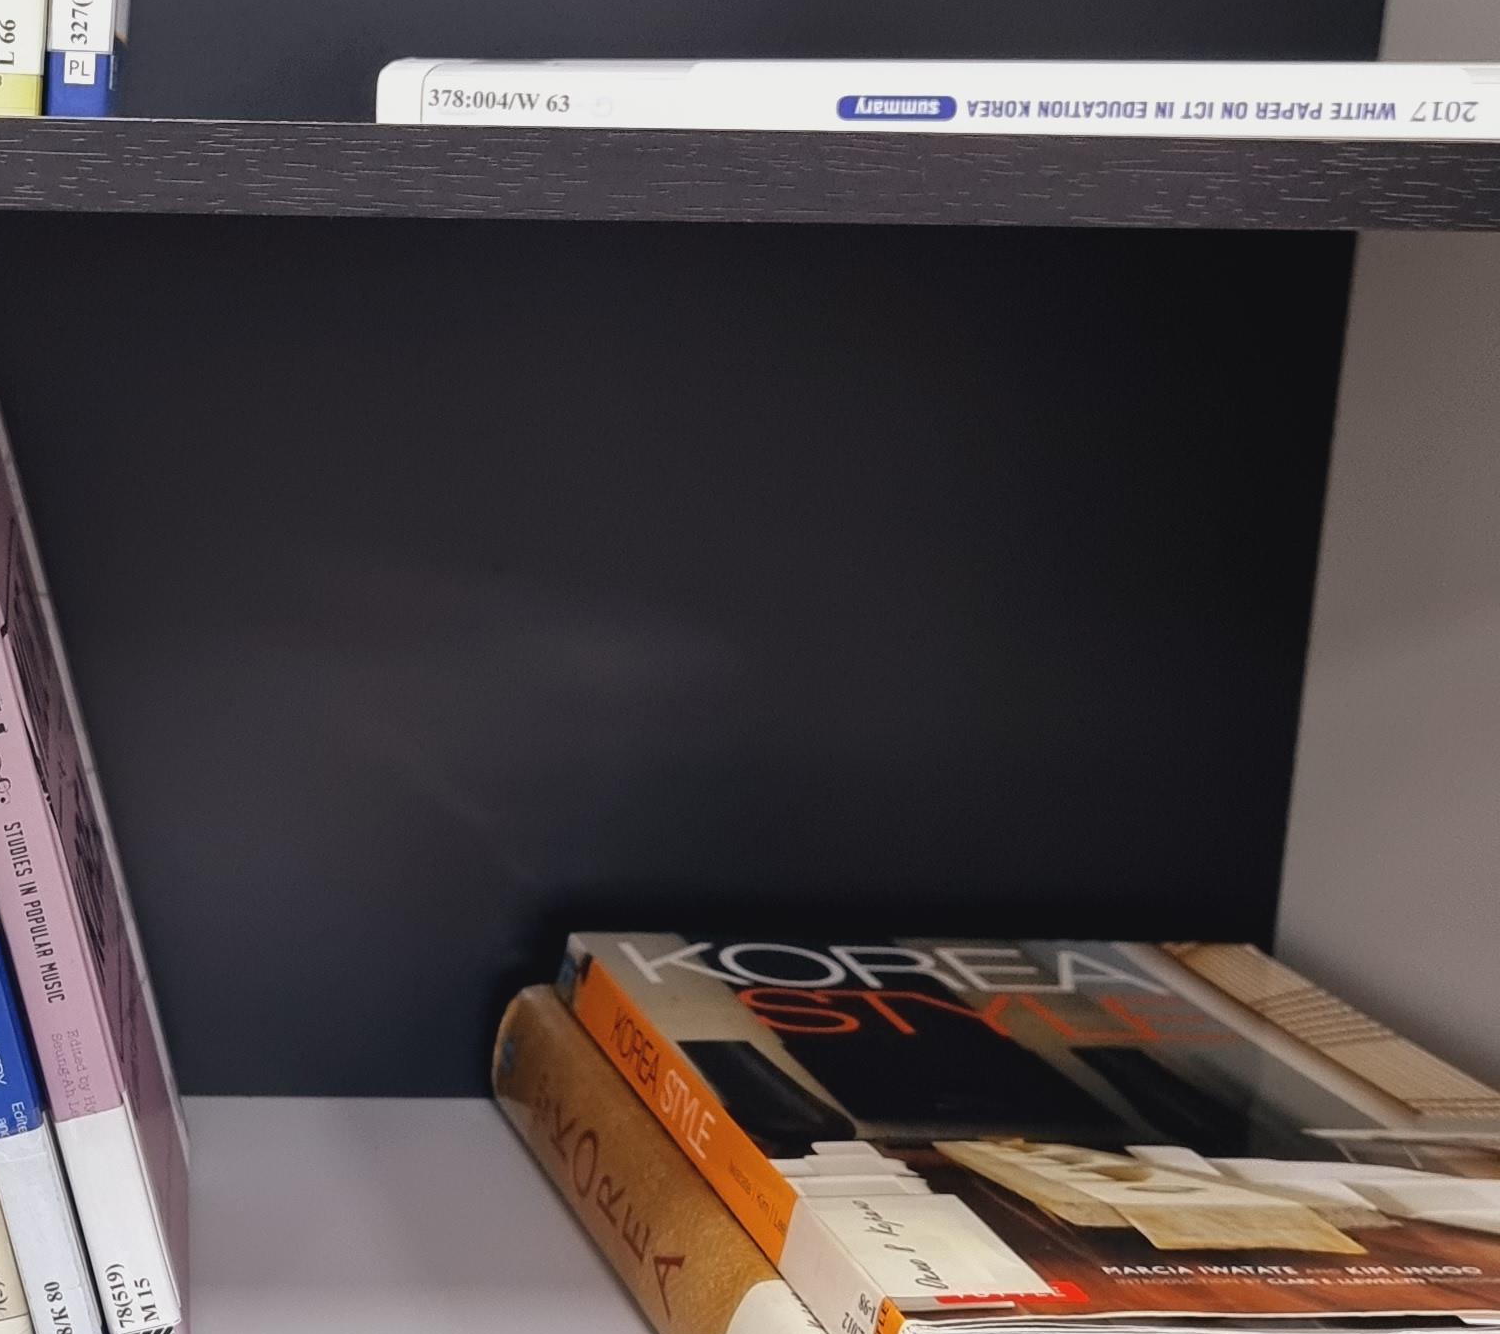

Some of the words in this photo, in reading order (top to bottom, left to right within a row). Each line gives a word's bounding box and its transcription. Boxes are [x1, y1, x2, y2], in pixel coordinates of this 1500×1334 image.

[0, 19, 16, 45] 66
[428, 88, 540, 112] 378:004/W
[546, 94, 570, 113] 63
[966, 99, 1030, 118] KOREA
[1038, 99, 1148, 119] EDUCATION
[1181, 101, 1214, 120] ICT
[1221, 101, 1248, 120] ON
[1255, 101, 1322, 120] PAPER
[1330, 101, 1396, 121] WHITE
[1411, 100, 1480, 123] 2017
[618, 941, 1178, 994] KOREA
[659, 1068, 716, 1160] STYLE
[549, 1105, 686, 1319] KOREA
[1101, 1265, 1195, 1276] MARCIA
[1198, 1265, 1298, 1276] IWATATE
[1345, 1265, 1390, 1276] KIM
[44, 1281, 63, 1302] 80
[135, 1278, 151, 1296] 15
